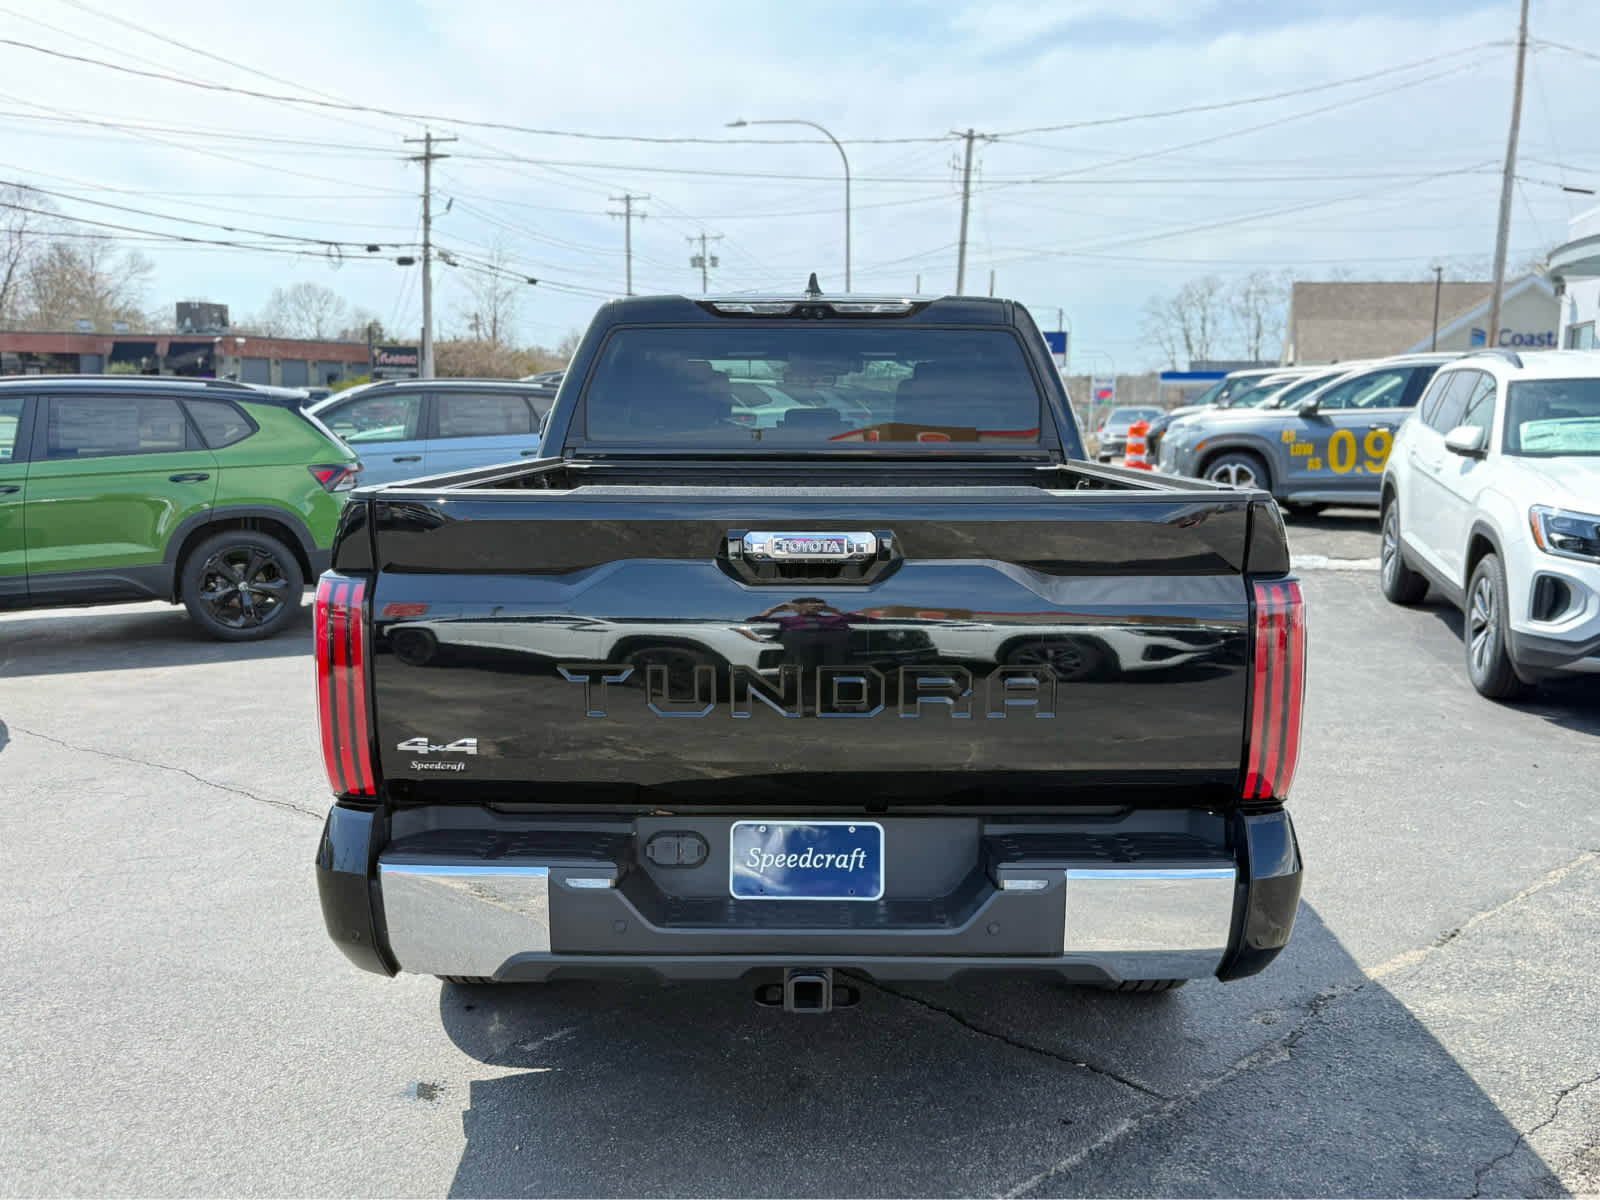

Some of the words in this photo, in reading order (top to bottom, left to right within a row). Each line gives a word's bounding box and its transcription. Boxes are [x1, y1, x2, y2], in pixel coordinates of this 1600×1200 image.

[1499, 327, 1559, 347] Coast
[1327, 429, 1393, 475] 0.9
[781, 540, 841, 553] TOYOTA
[556, 663, 1058, 719] TUNDRA
[397, 737, 477, 754] 4x4
[410, 760, 465, 772] Speedcraft
[746, 847, 868, 873] Speedcraft
